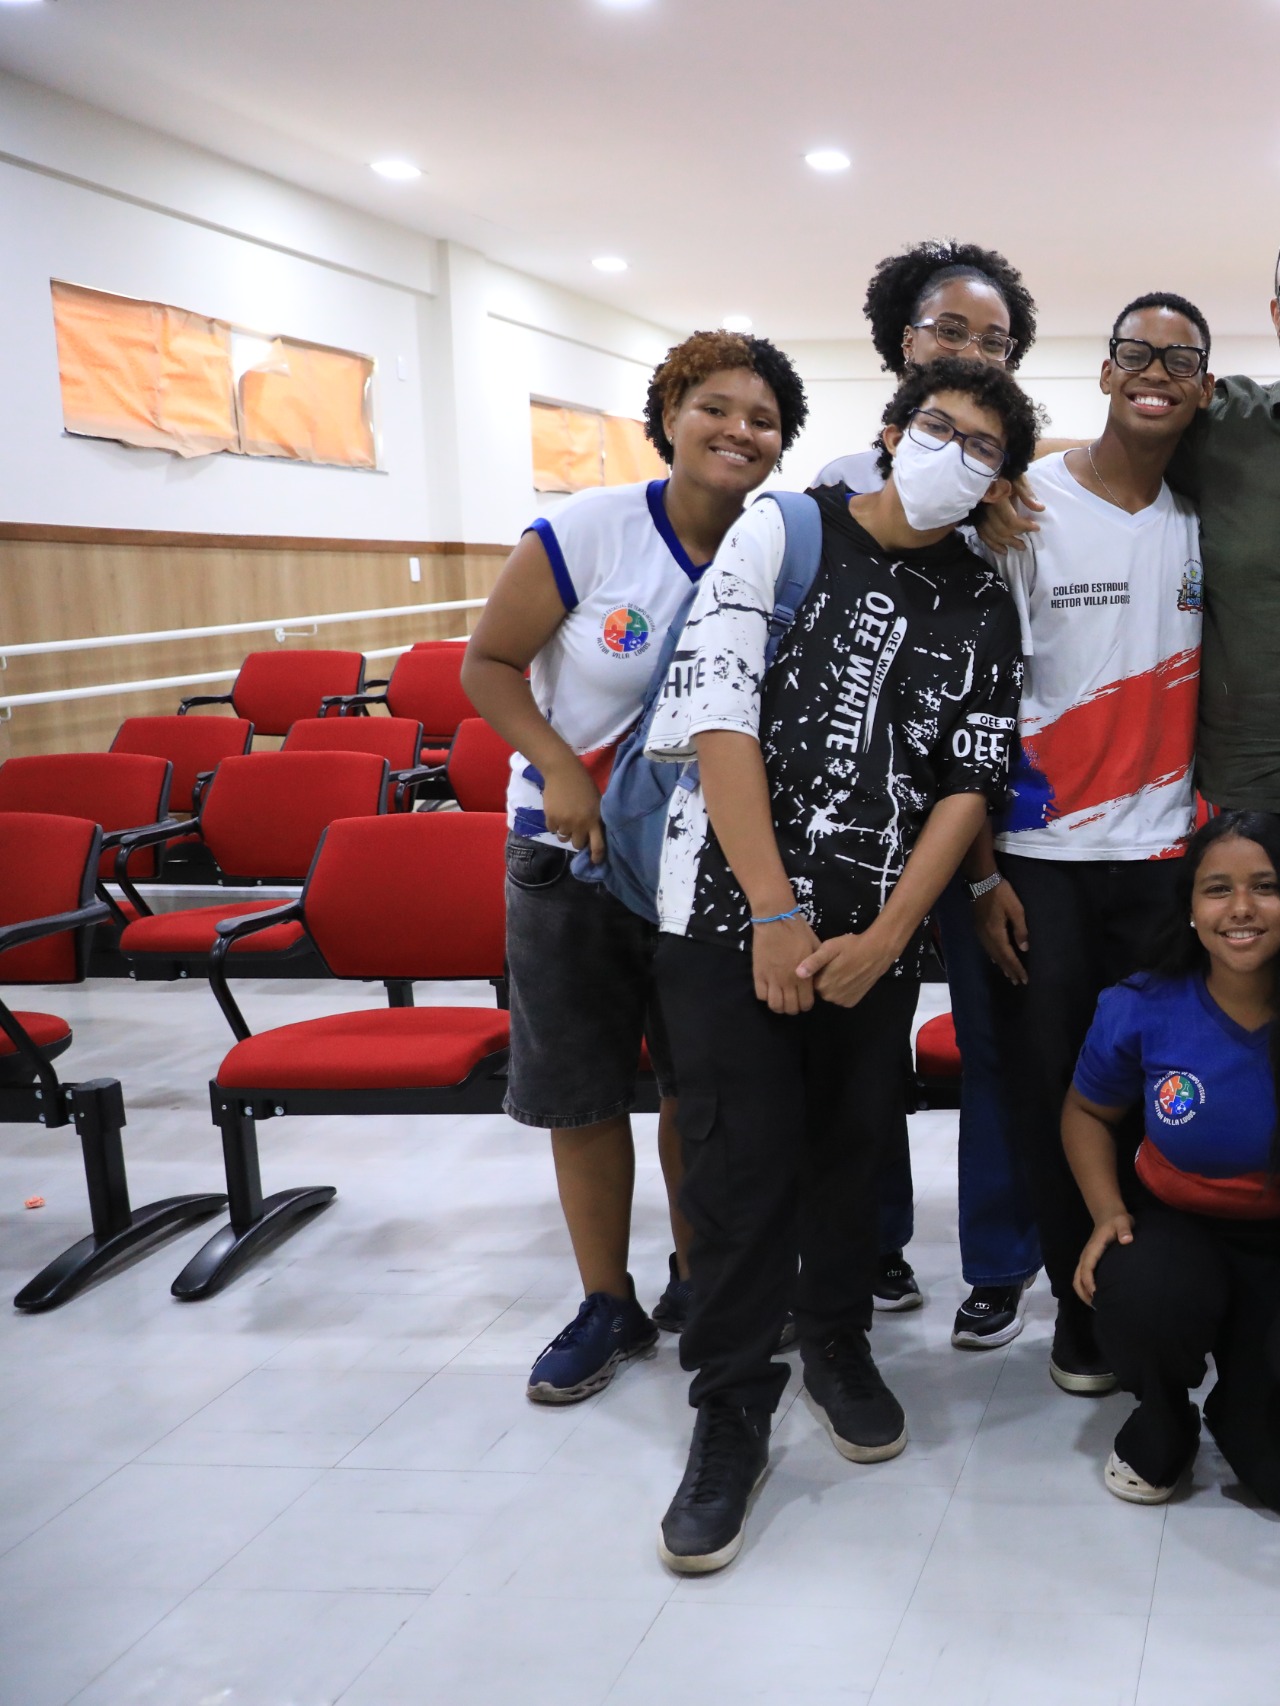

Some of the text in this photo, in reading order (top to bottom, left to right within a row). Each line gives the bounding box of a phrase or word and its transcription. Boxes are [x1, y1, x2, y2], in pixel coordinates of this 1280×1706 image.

[1053, 583, 1089, 596] COLÉGIO
[1051, 597, 1081, 609] HEITOR
[1084, 595, 1108, 606] VILLA
[611, 651, 630, 659] VILLA
[871, 658, 890, 700] WHITE
[826, 653, 874, 754] WHITE
[1163, 1116, 1180, 1126] VILLA
[1180, 1110, 1196, 1125] LOBOS
